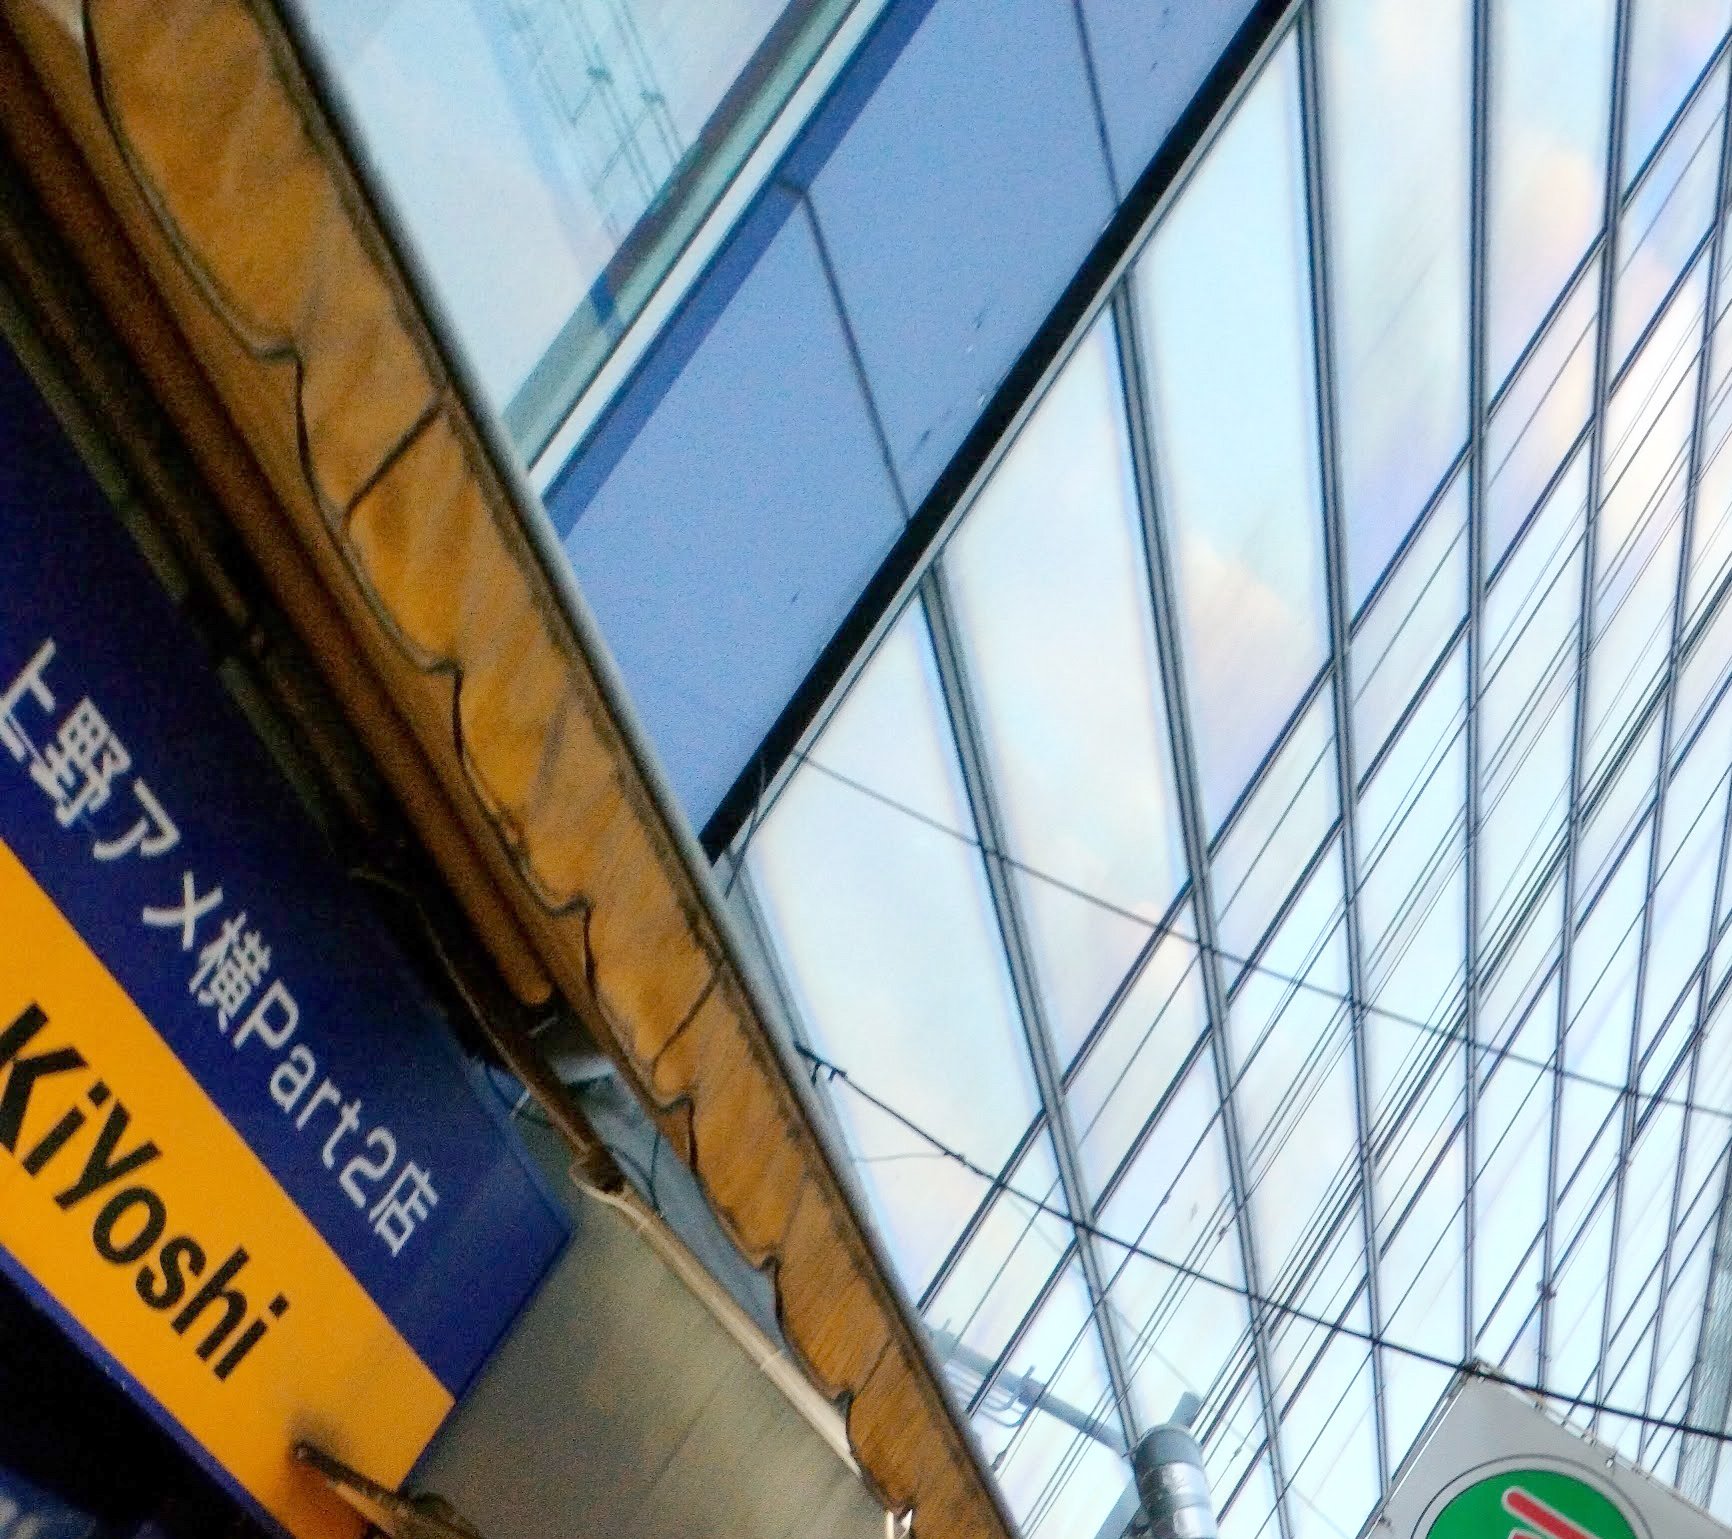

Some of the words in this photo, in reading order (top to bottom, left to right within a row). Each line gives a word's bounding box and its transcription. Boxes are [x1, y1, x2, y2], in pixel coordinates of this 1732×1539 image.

[0, 637, 440, 1258] 上野アメ横Part2店
